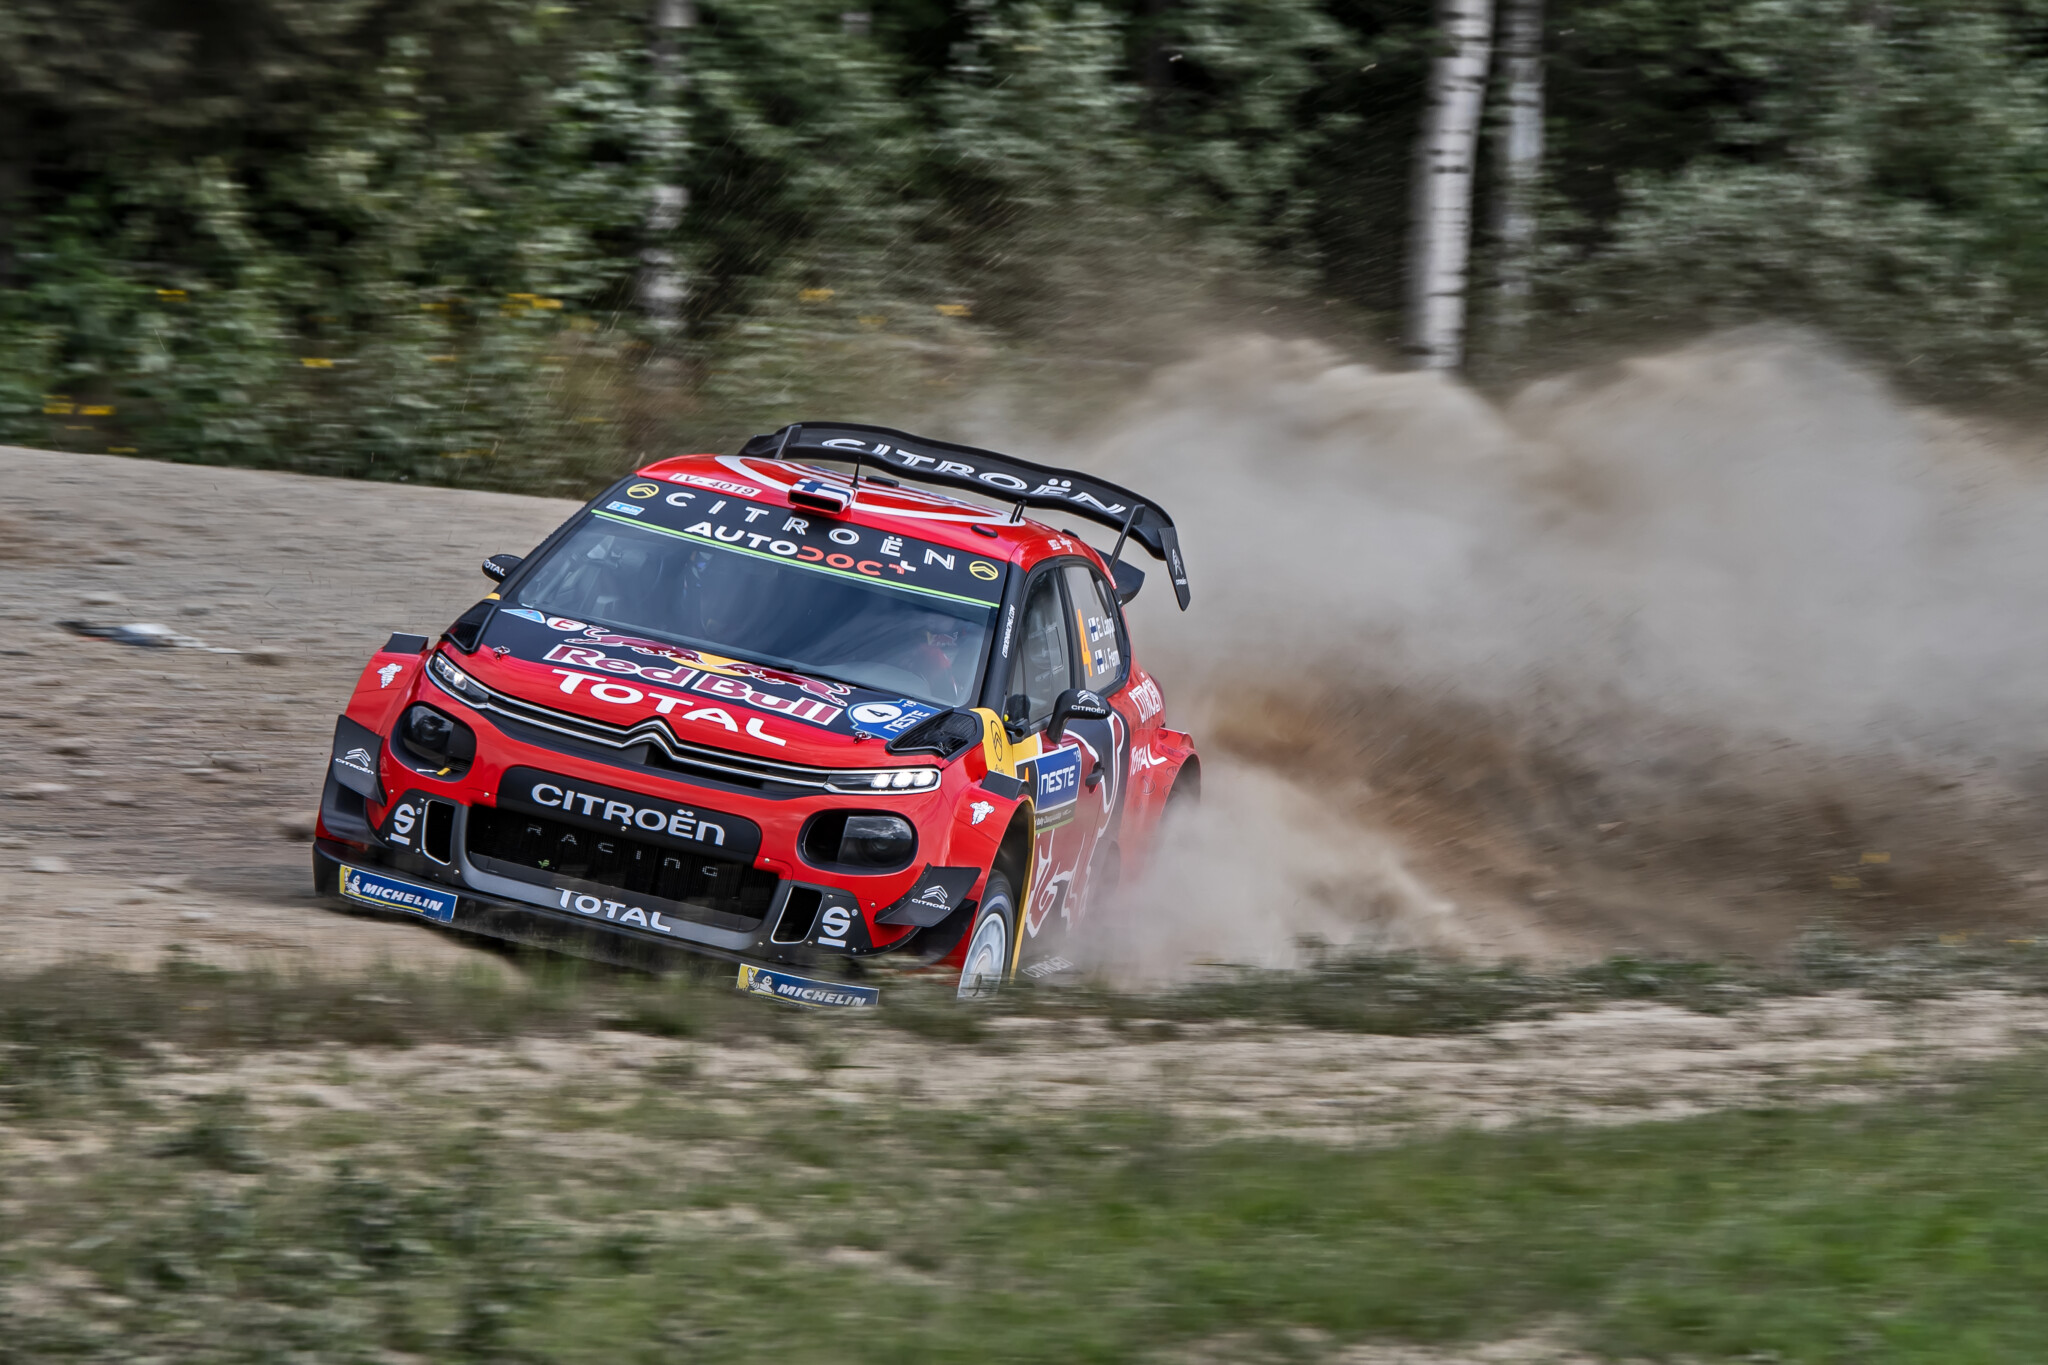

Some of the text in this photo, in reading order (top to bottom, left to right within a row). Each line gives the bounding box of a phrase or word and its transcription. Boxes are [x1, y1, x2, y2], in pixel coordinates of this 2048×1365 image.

[822, 438, 1126, 515] CITROËN
[665, 491, 955, 571] CITROËN
[542, 643, 846, 726] Red Bull
[552, 668, 788, 747] TOTAL
[866, 708, 892, 717] 4
[883, 710, 931, 733] NESTE
[1071, 704, 1106, 714] CITROËN
[335, 758, 375, 775] CITROËN
[1130, 744, 1168, 777] TOTAL
[1041, 765, 1075, 796] NESTE
[531, 782, 725, 846] CITROËN
[526, 823, 718, 877] RACING
[362, 882, 443, 912] MICHELIN
[555, 887, 672, 932] TOTAL
[911, 898, 951, 911] CITROËN
[777, 983, 866, 1007] MICHELIN
